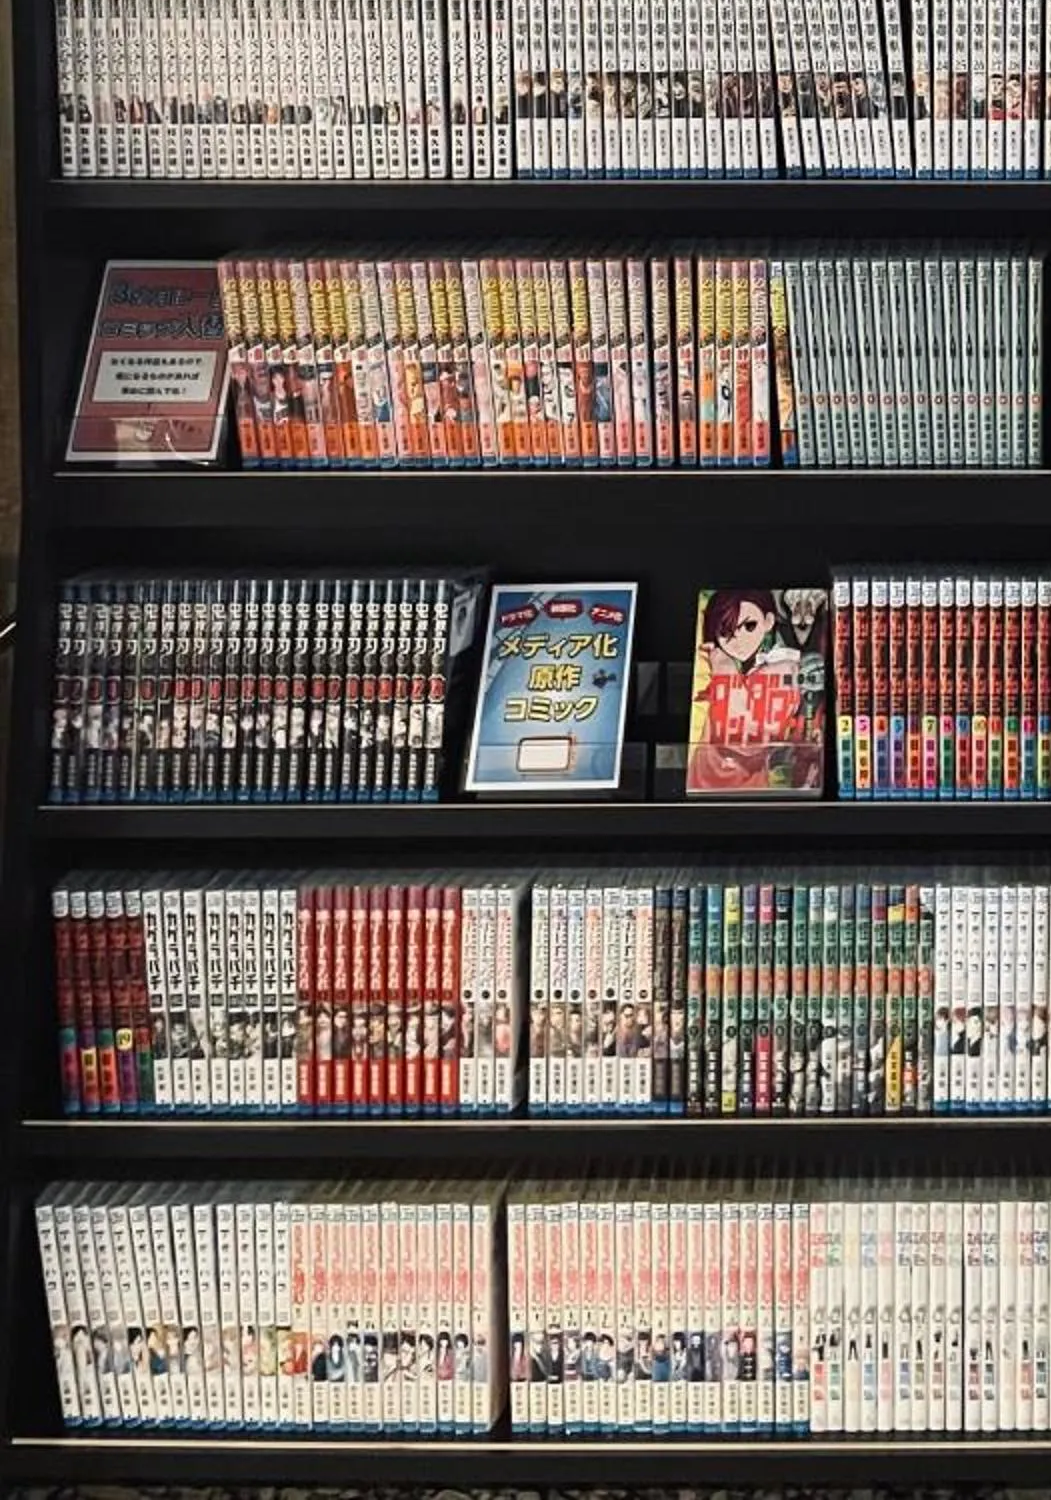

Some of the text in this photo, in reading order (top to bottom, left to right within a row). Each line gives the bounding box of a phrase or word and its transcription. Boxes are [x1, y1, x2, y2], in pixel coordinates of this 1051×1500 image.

[499, 633, 618, 658] メディア化
[529, 664, 582, 691] 原作
[504, 697, 598, 721] コミック
[146, 912, 161, 990] カグラバチ
[167, 912, 181, 990] カグラバチ
[187, 912, 200, 990] カグラバチ
[210, 912, 224, 990] カグラバチ
[228, 912, 243, 990] カグラバチ
[245, 912, 259, 990] カグラバチ
[264, 912, 279, 990] カグラバチ
[283, 912, 296, 990] カグラバチ
